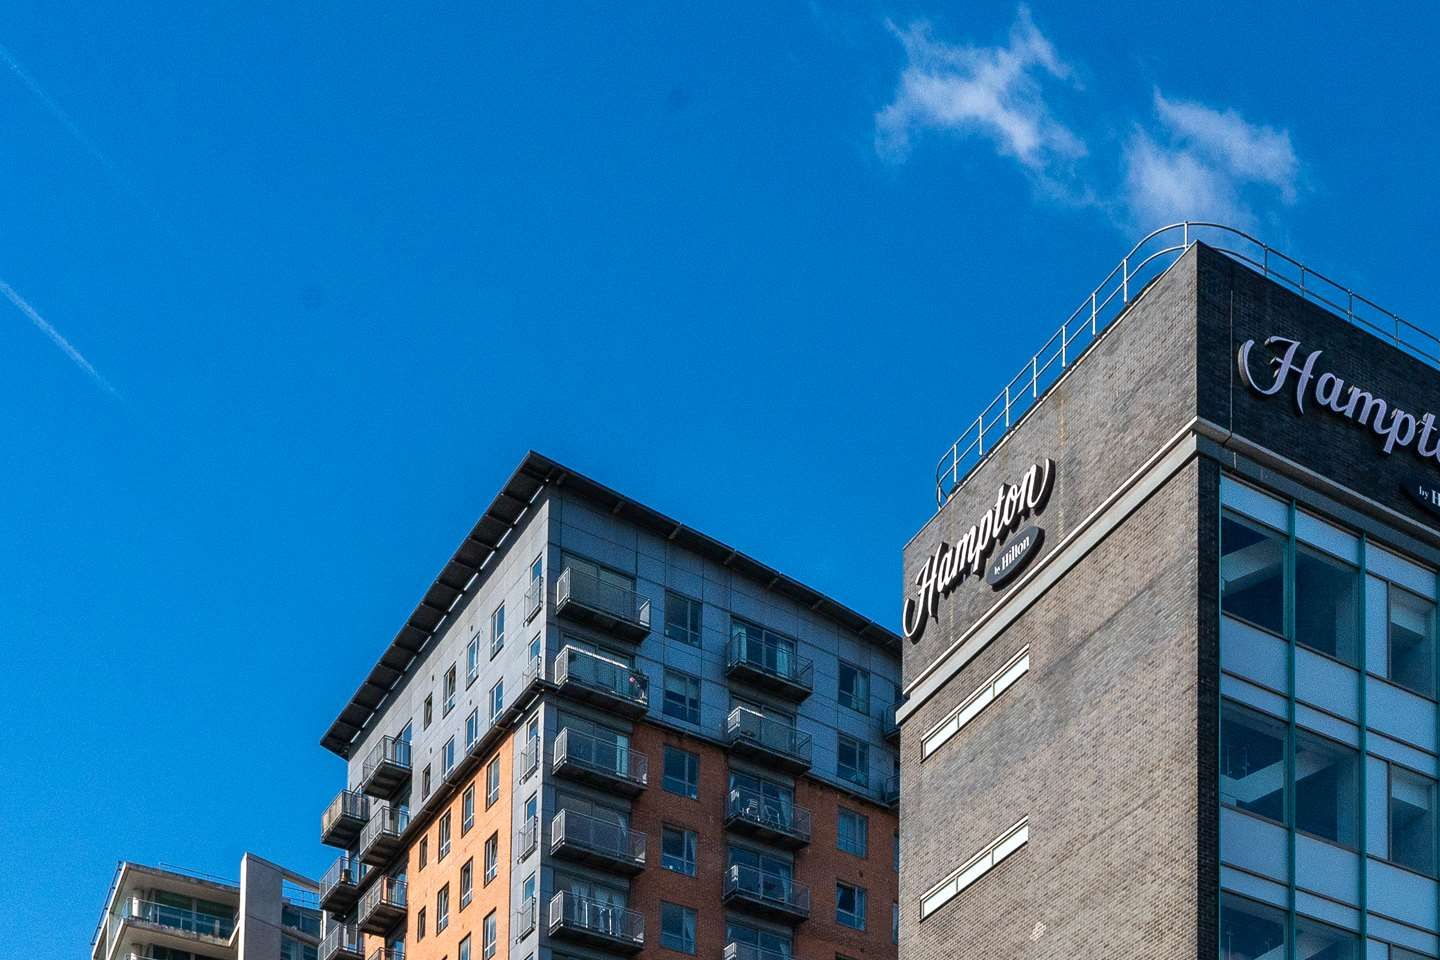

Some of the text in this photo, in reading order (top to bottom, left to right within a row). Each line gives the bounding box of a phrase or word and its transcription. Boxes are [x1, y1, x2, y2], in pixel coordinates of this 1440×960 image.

[1418, 485, 1430, 500] by
[903, 458, 1053, 640] Hampton
[1002, 536, 1030, 571] Hilton
